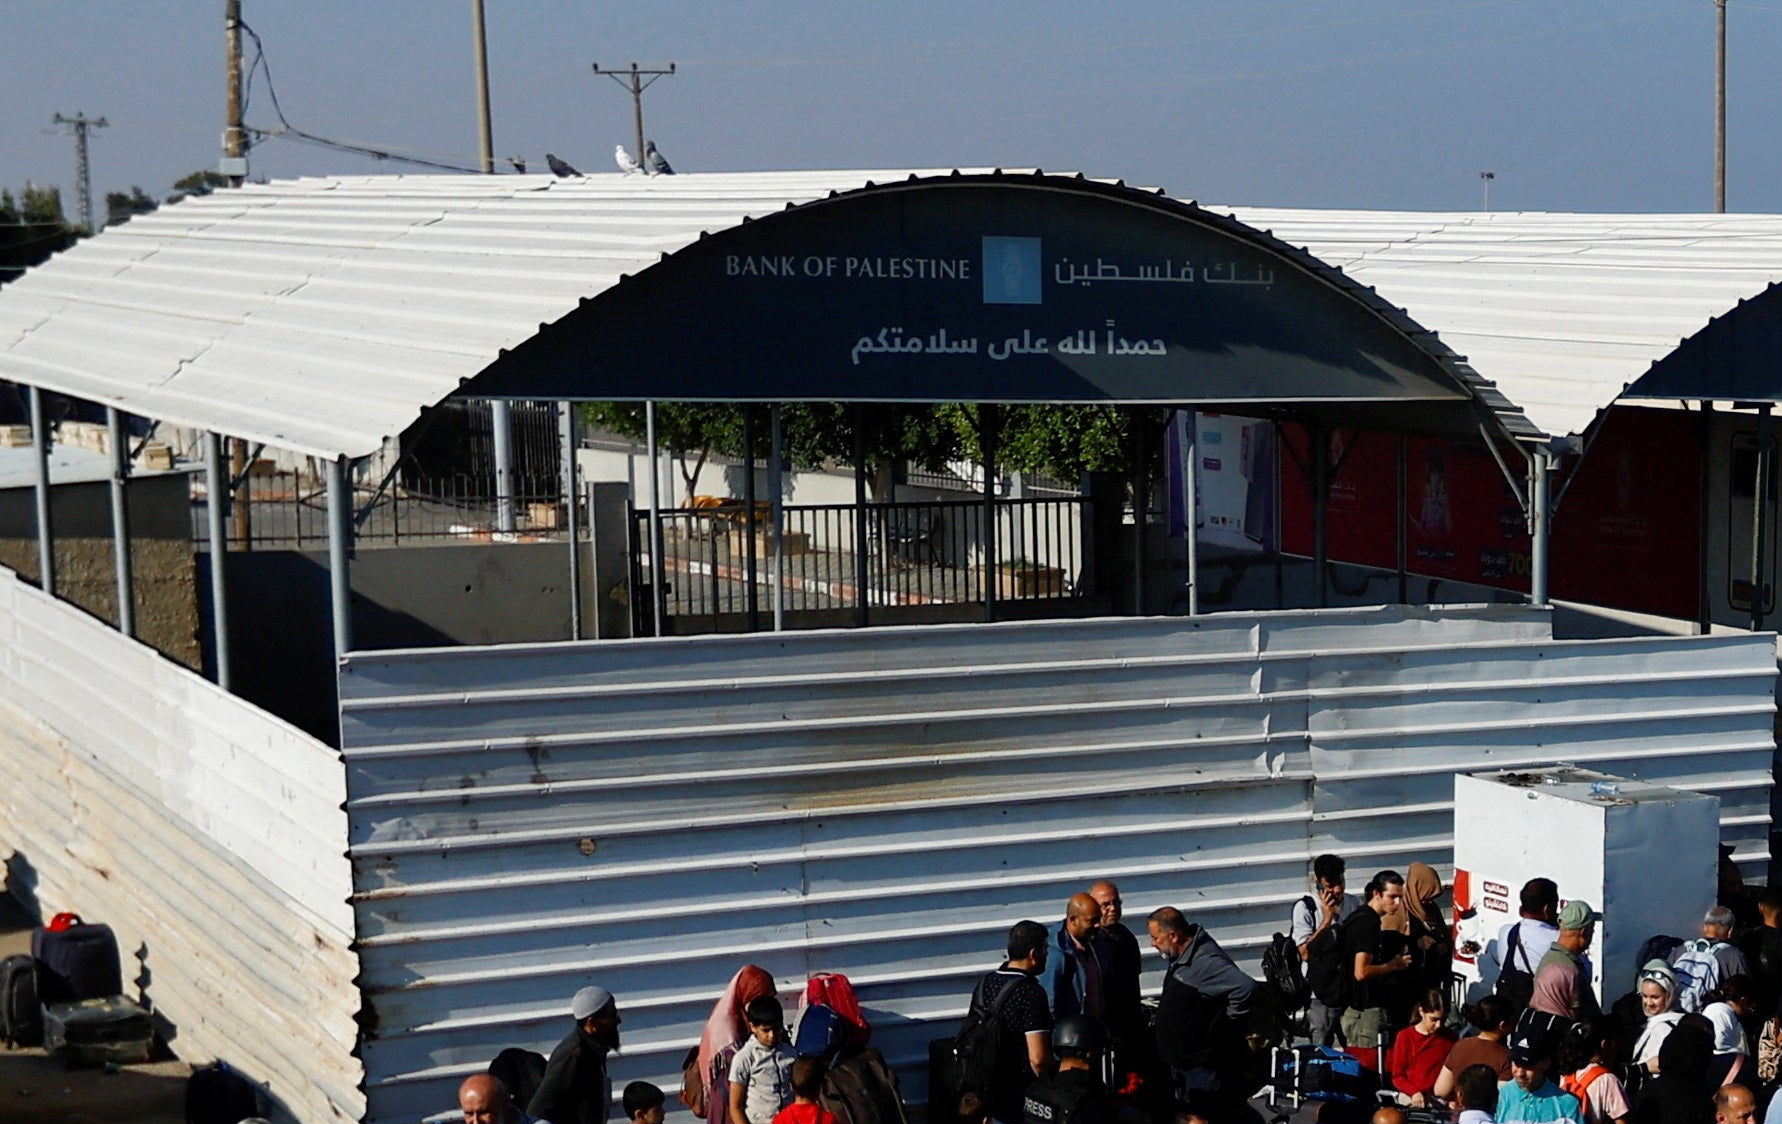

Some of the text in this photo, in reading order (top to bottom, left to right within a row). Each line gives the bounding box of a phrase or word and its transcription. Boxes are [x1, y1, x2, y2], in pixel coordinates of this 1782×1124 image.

[726, 255, 971, 280] BANK OF PALESTINE
[1053, 256, 1275, 290] بنك فلسطين
[851, 326, 978, 365] سلامتكم
[987, 330, 1049, 360] على
[1058, 329, 1097, 356] لله
[1024, 1096, 1053, 1120] PRESS
